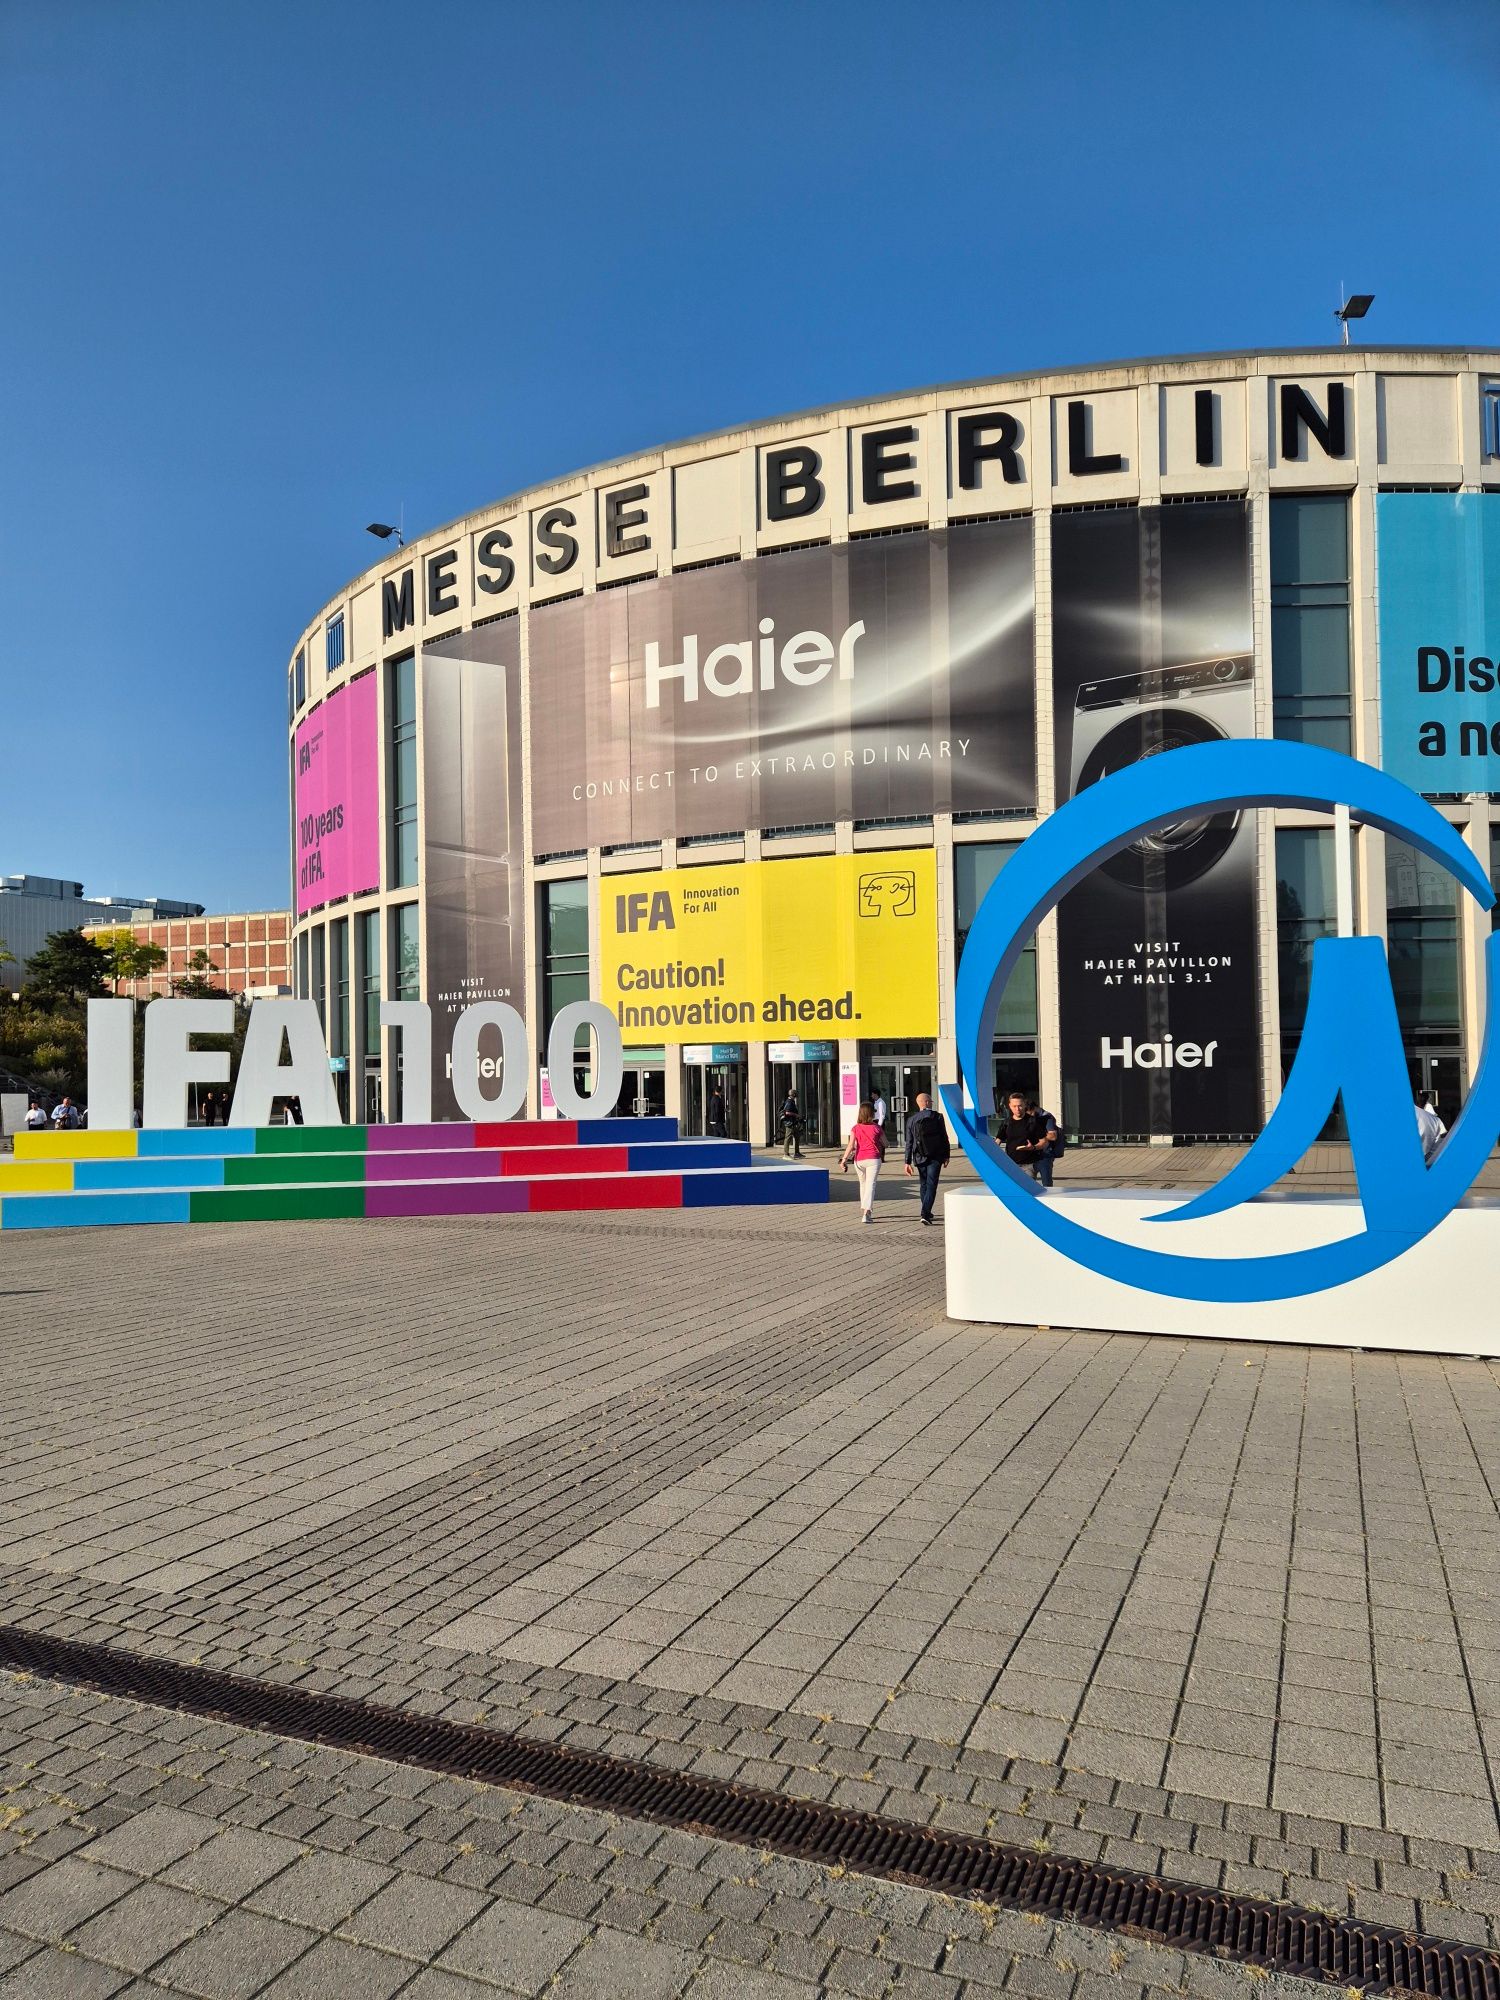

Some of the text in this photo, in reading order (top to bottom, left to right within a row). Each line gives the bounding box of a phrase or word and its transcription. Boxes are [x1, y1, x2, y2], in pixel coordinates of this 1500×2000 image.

[381, 382, 1346, 637] MESSE BERLIN
[645, 617, 866, 708] Haier
[1417, 646, 1500, 693] Dis
[1418, 721, 1446, 757] a
[299, 741, 311, 776] IFA
[573, 738, 971, 801] CONNECT TO EXTRAORDINARY
[301, 804, 344, 849] 100 years
[301, 850, 325, 890] of IFA.
[616, 885, 740, 934] IFA Innovation
[683, 901, 717, 914] For All
[1084, 956, 1232, 970] HAIER PAVILLON
[1134, 942, 1181, 953] VISIT
[461, 977, 484, 987] VISIT
[617, 958, 725, 992] Caution!
[1104, 972, 1212, 985] AT HALL 3.1
[438, 988, 511, 1001] HAIER PAVILLON
[447, 1004, 457, 1012] AT
[618, 991, 862, 1027] Innovation ahead.
[87, 998, 624, 1127] IFA 100
[1101, 1034, 1218, 1068] Haier
